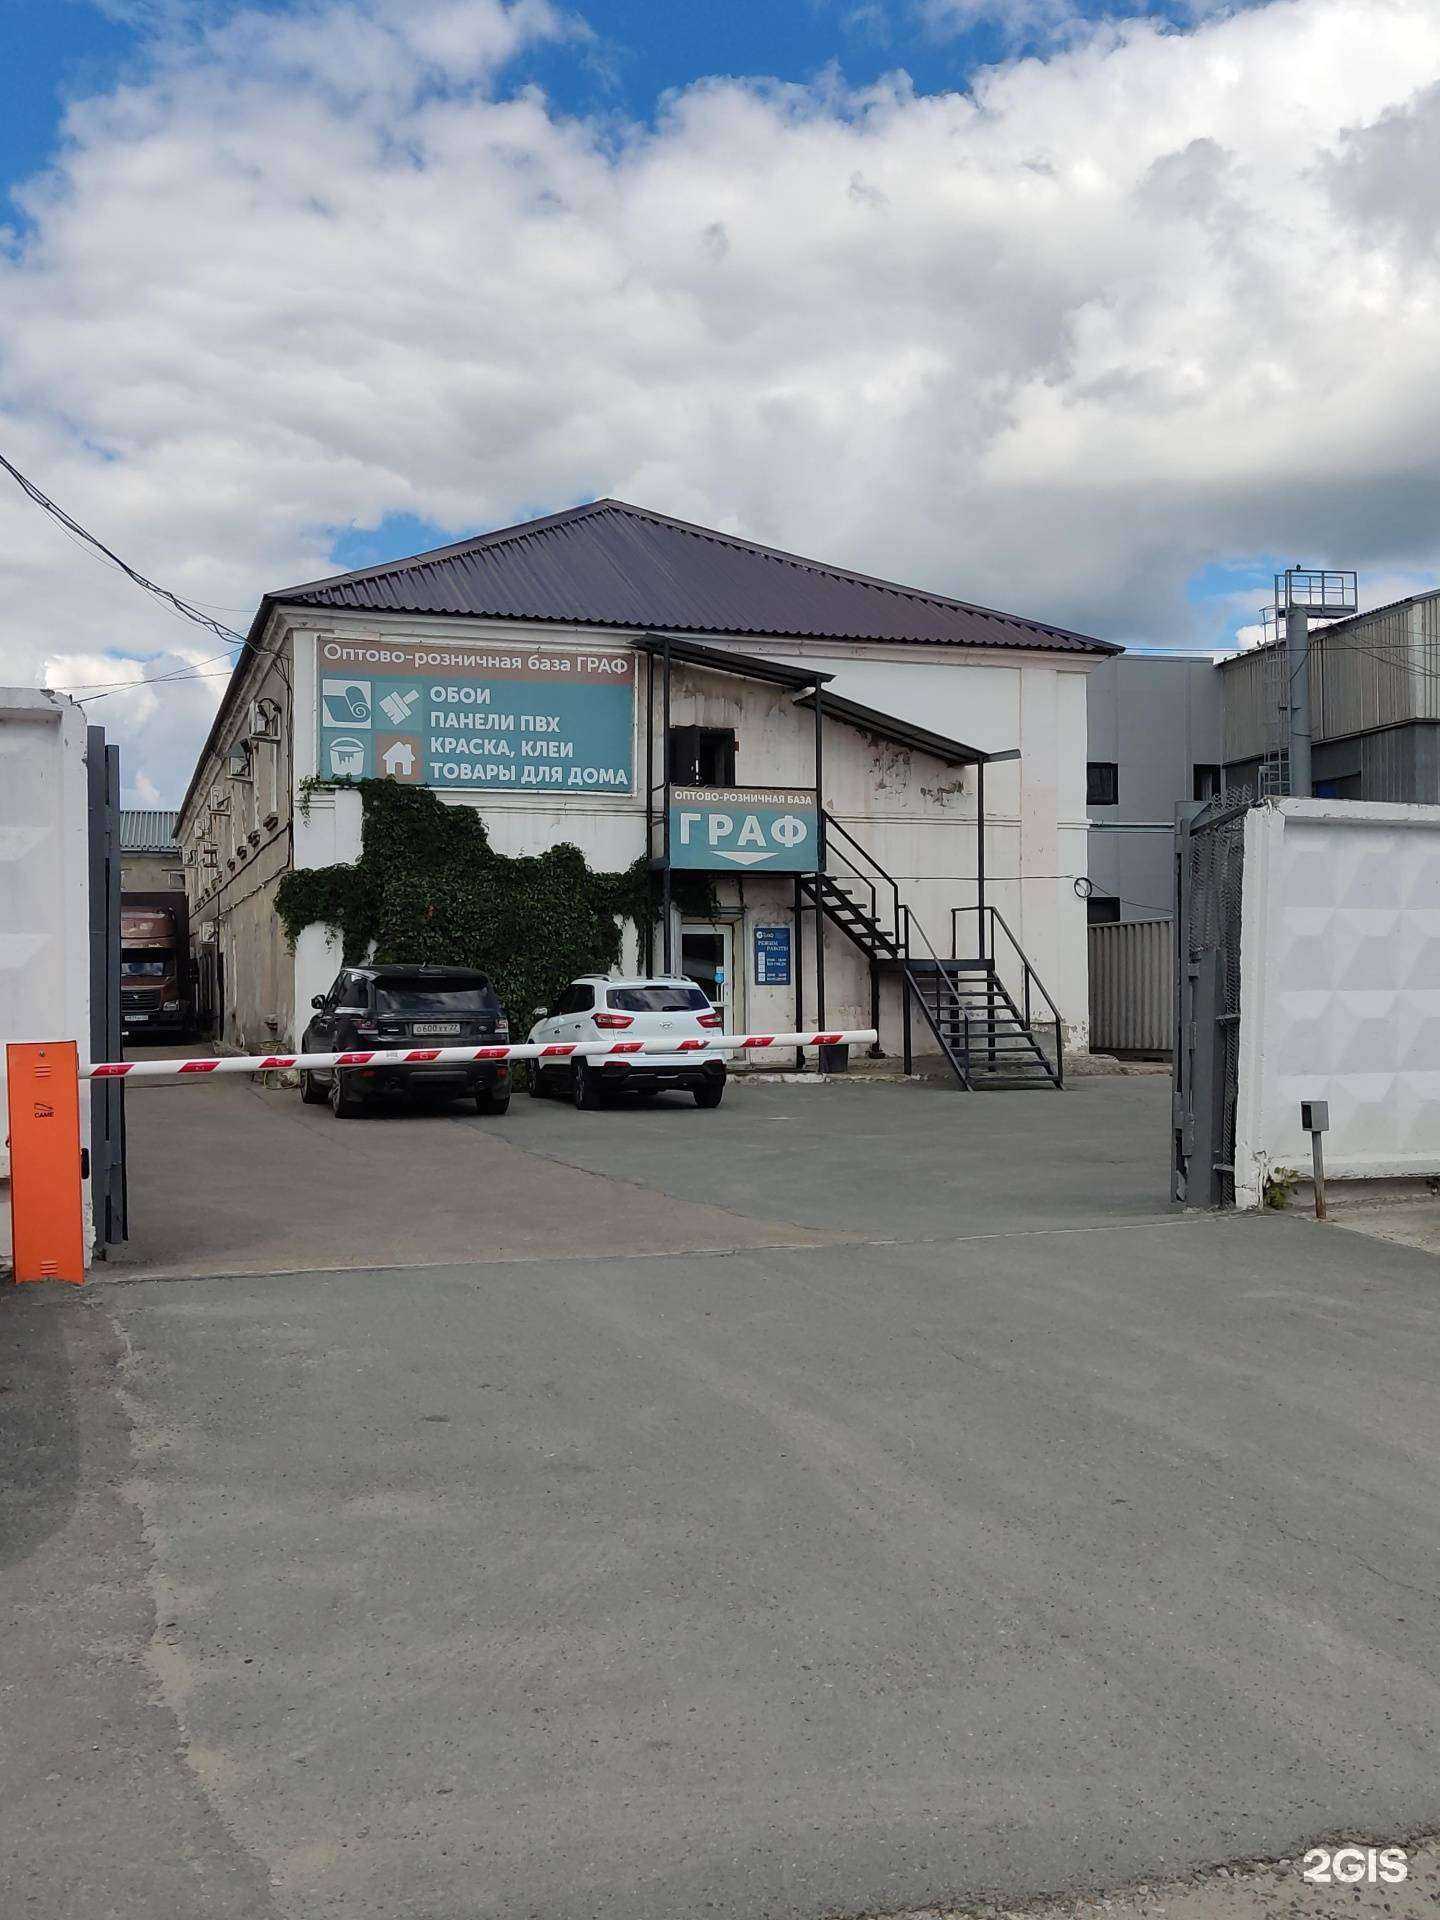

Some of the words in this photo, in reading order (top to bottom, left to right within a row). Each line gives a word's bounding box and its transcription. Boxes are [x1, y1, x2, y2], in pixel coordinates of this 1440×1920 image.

[323, 643, 522, 670] Оптово-розничная
[527, 654, 571, 672] база
[576, 656, 629, 675] ГРАФ
[429, 686, 492, 705] ОБОИ
[430, 711, 516, 731] ПАНЕЛИ
[519, 714, 562, 733] ПВХ
[430, 737, 516, 758] КРАСКА,
[520, 740, 574, 758] КЛЕИ
[429, 761, 517, 781] ТОВАРЫ
[520, 765, 563, 785] ДЛЯ
[566, 766, 629, 786] ДОМА
[674, 791, 786, 805] ОПТОВО-РОЗНИЧНАЯ
[787, 796, 813, 806] БАЗА
[680, 812, 808, 848] ГРАФ
